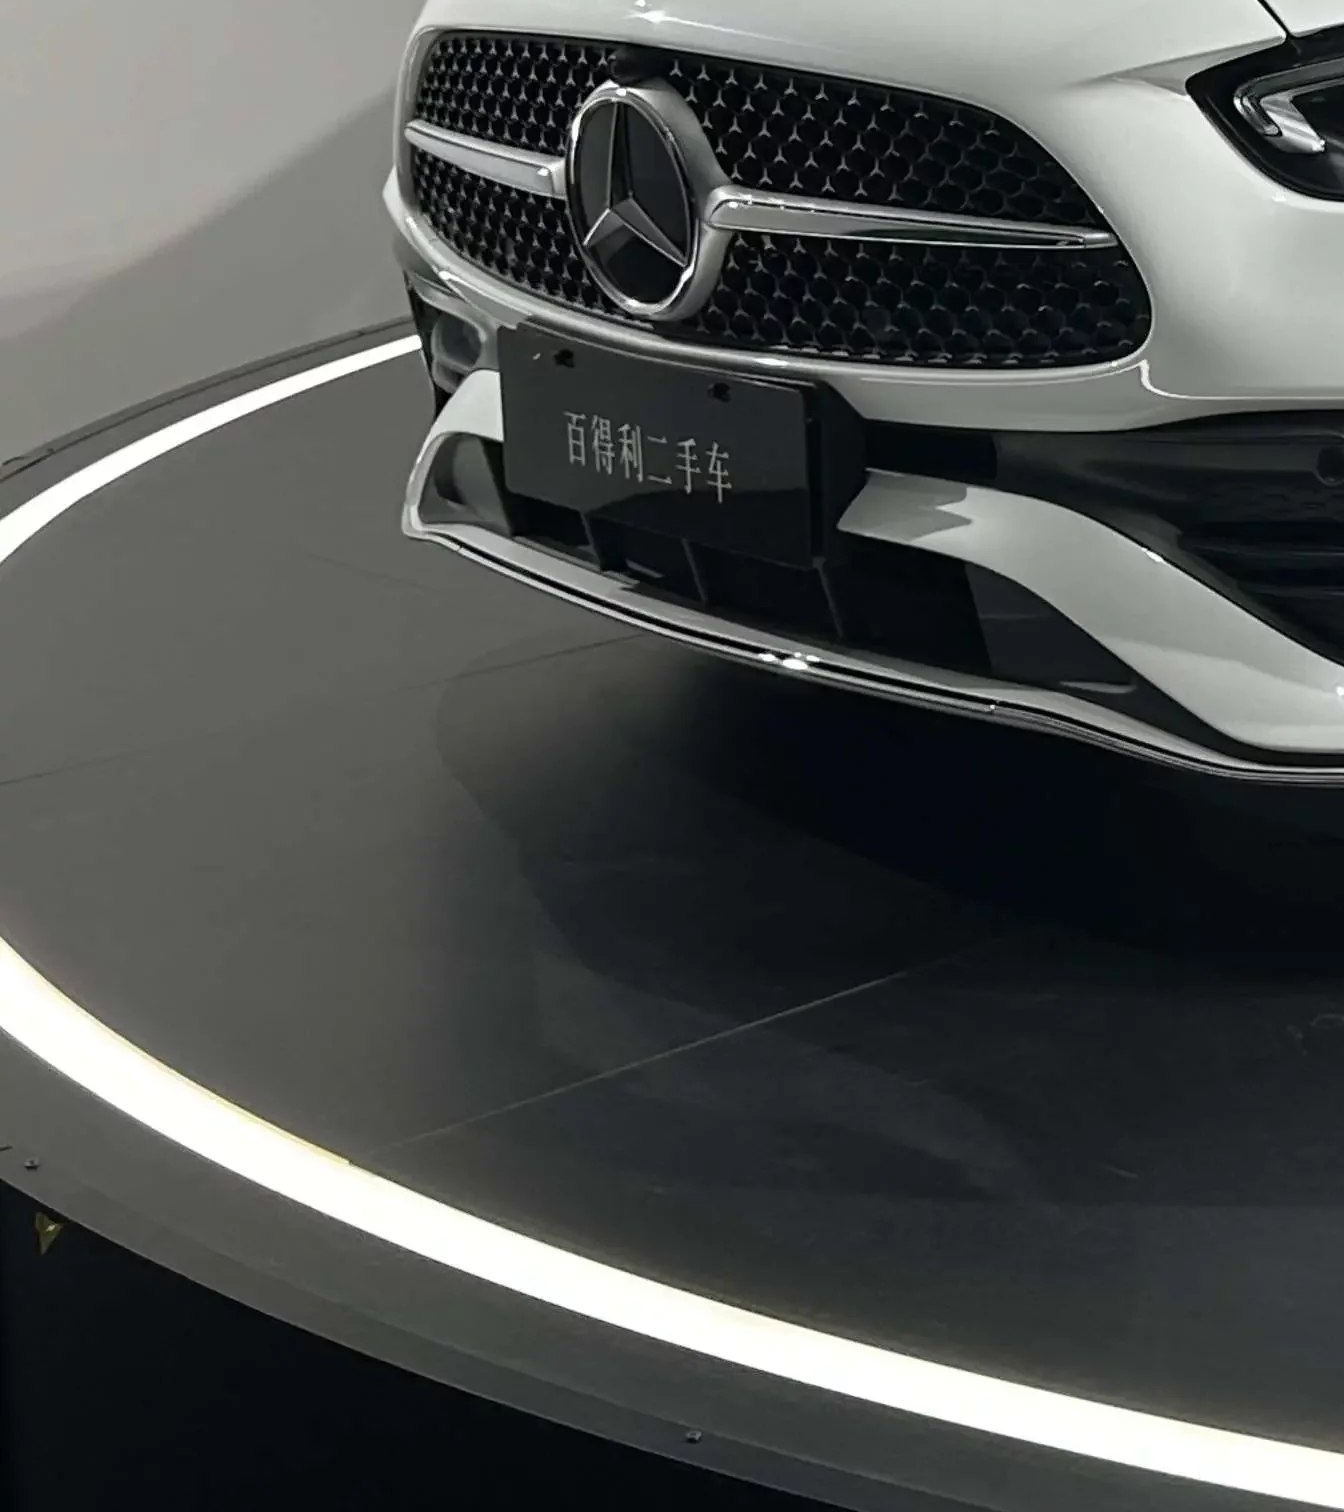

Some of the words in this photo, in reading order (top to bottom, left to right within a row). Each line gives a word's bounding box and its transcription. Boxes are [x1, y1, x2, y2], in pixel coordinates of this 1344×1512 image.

[563, 410, 733, 504] 百得利二手车
